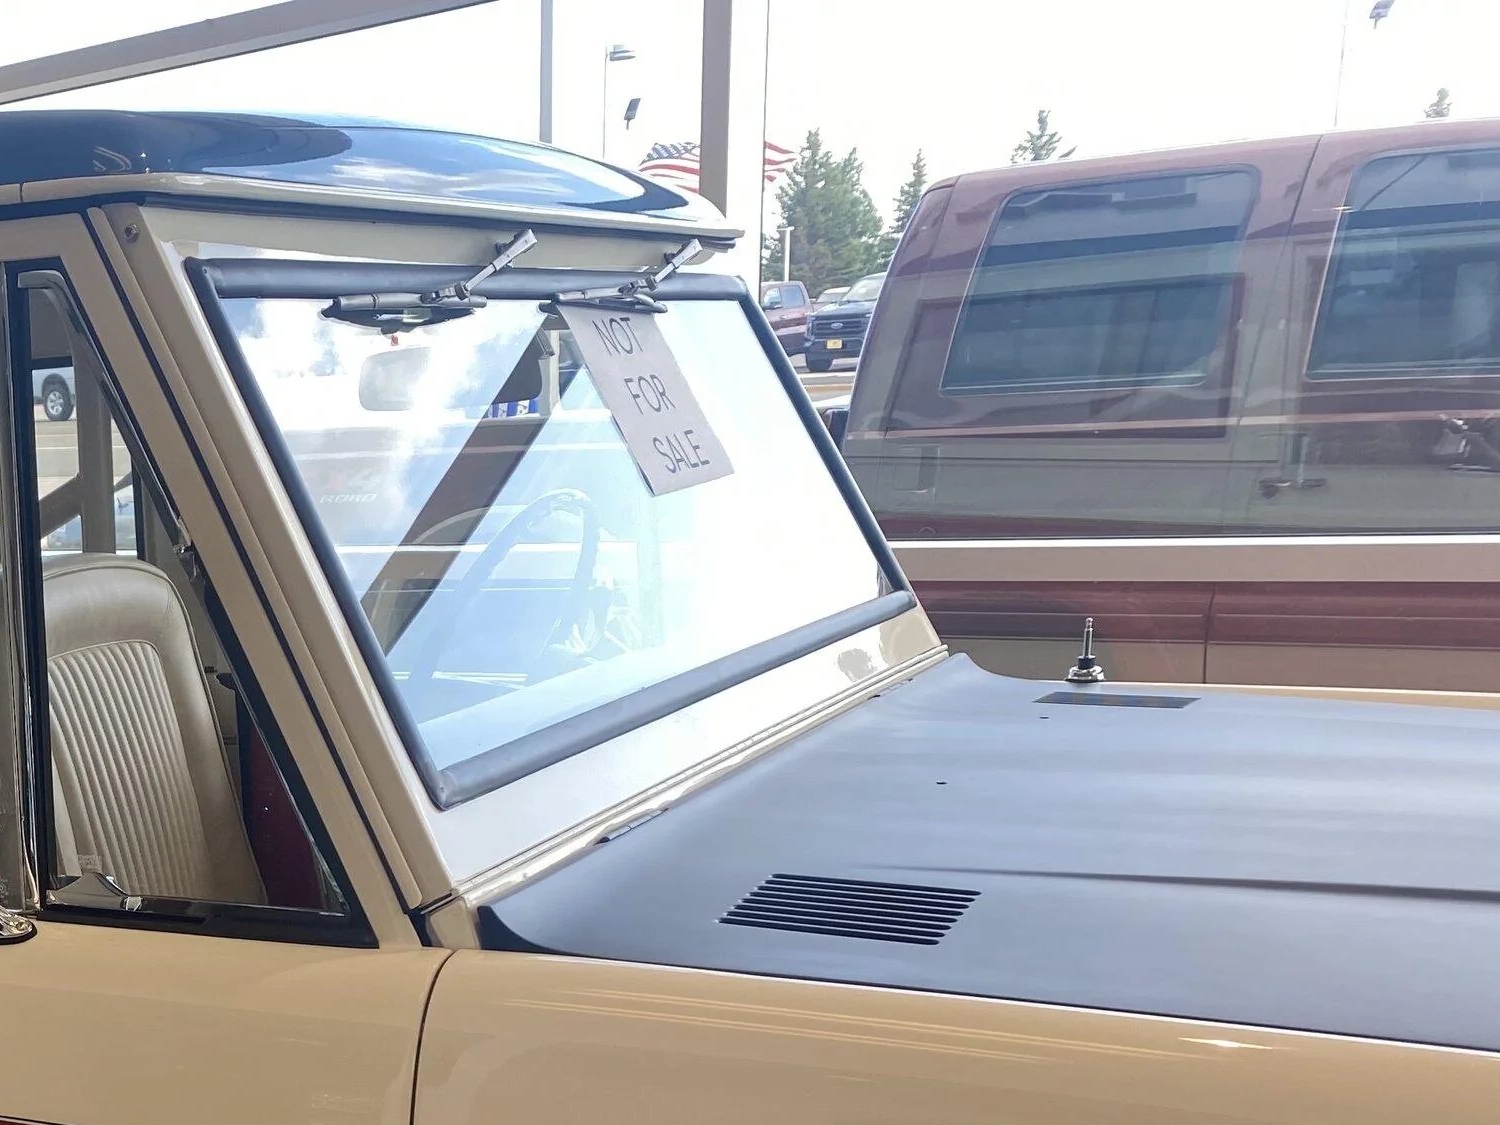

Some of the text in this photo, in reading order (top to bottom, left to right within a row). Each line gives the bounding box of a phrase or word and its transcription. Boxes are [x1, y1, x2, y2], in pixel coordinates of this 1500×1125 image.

[592, 316, 644, 356] NOT
[623, 374, 676, 416] FOR
[651, 429, 711, 475] SALE
